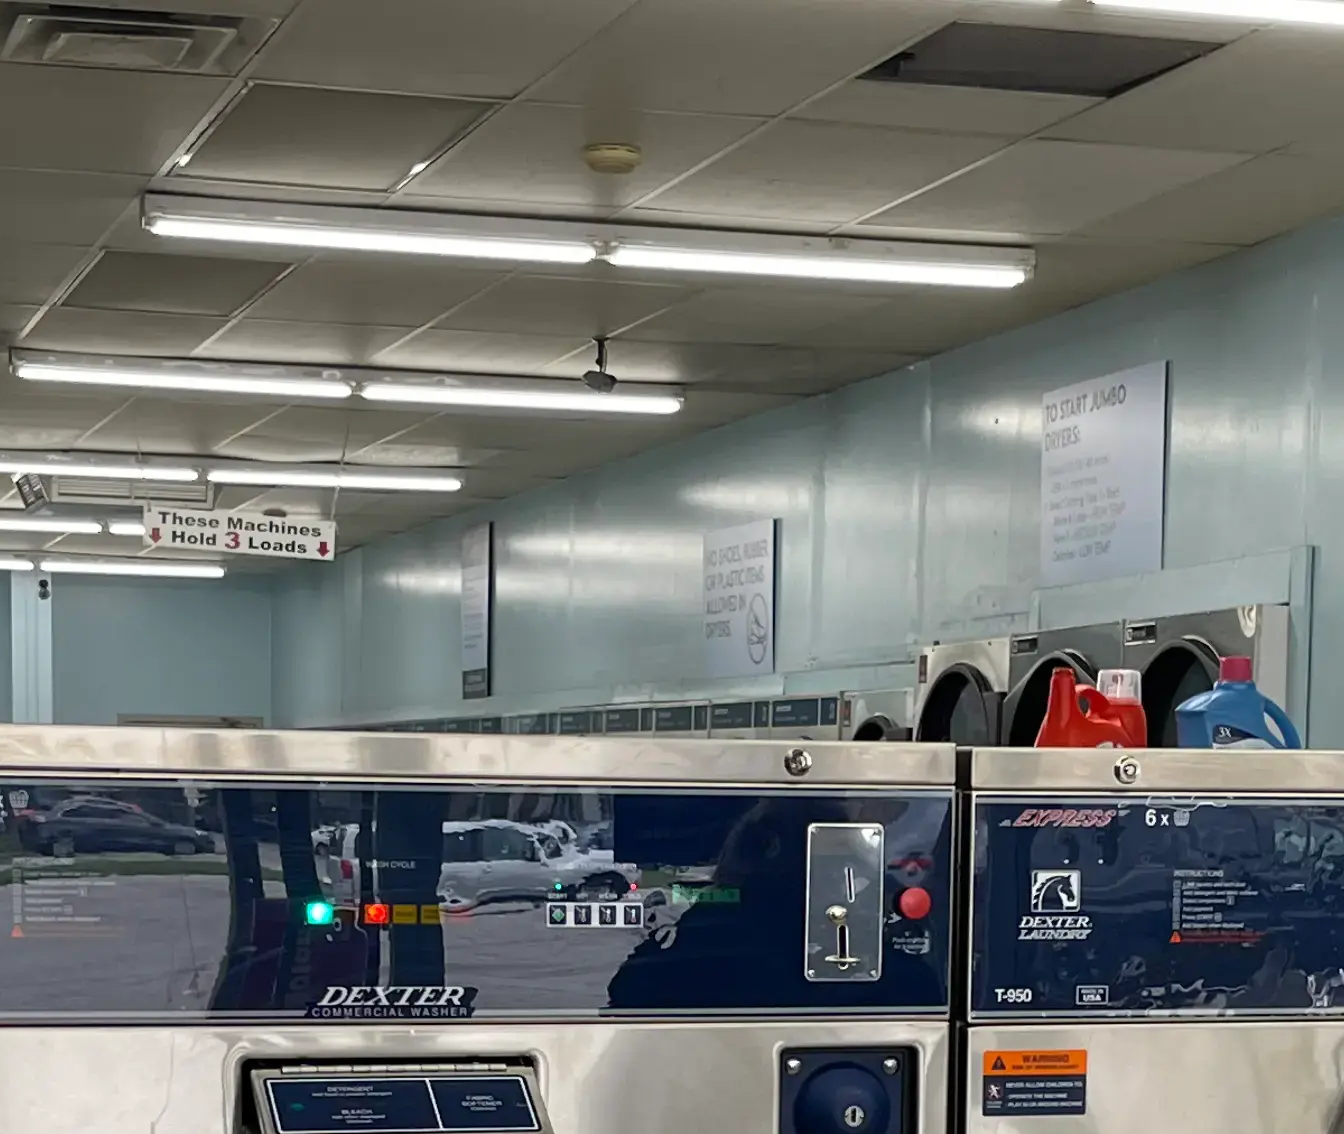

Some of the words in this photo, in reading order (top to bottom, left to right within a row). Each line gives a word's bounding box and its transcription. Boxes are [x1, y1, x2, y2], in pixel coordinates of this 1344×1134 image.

[158, 512, 219, 528] These
[228, 517, 321, 537] Machines
[172, 531, 216, 546] Hold
[225, 531, 241, 549] 3
[248, 536, 307, 554] Loads
[1219, 728, 1231, 737] 3X
[1013, 809, 1117, 827] EXPRESS
[1145, 809, 1156, 826] 6
[1161, 814, 1169, 826] x
[1019, 916, 1090, 928] DEXTER
[1018, 929, 1092, 939] LAUNDRY
[317, 986, 464, 1006] DEXTER
[995, 989, 1032, 1002] T-950
[311, 1007, 404, 1016] COMMERCIAL
[411, 1007, 467, 1016] WASHER
